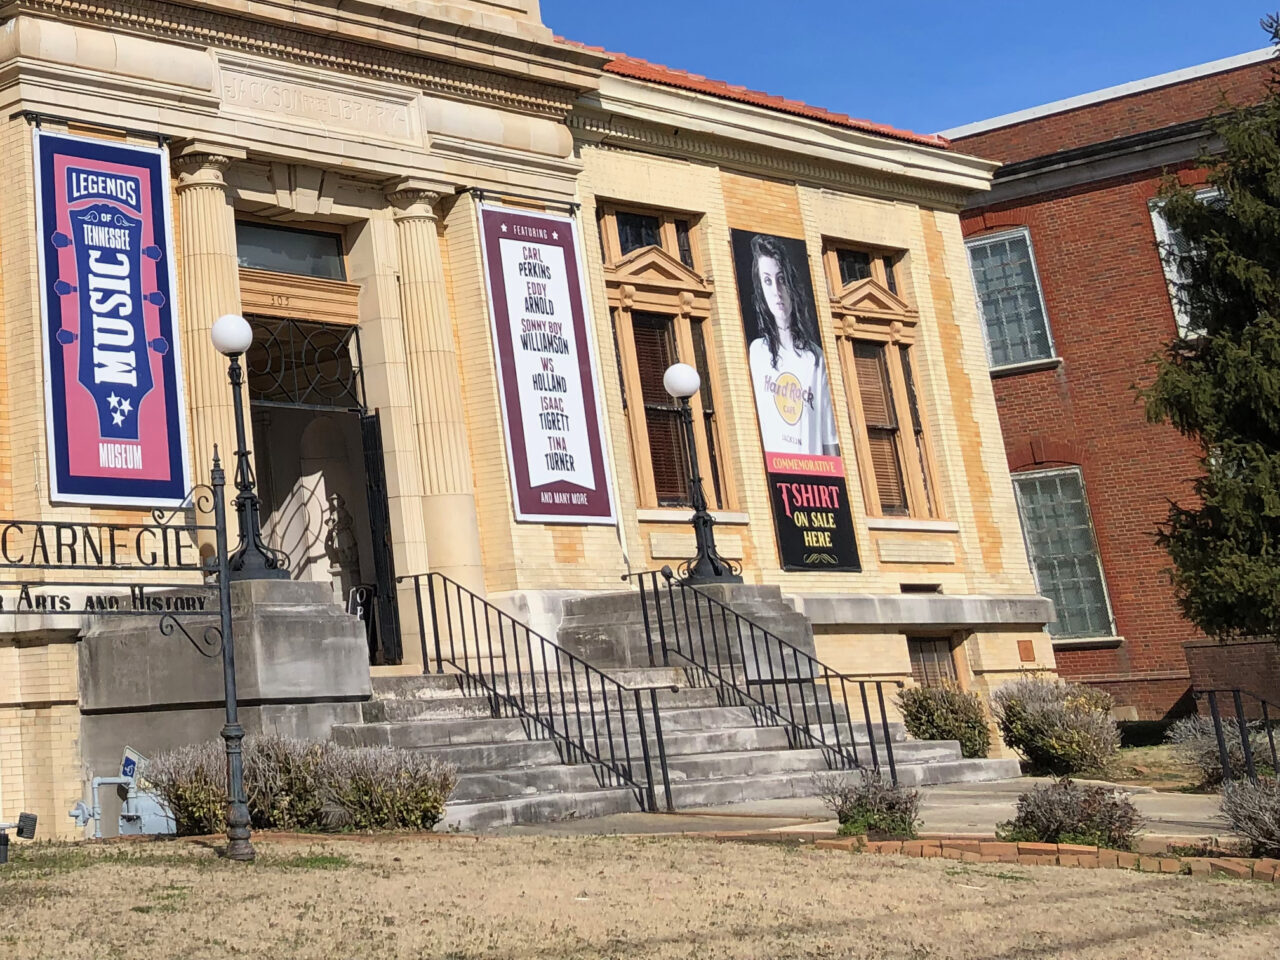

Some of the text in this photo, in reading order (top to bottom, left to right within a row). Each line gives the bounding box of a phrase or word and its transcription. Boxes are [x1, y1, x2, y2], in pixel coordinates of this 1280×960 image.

[72, 172, 137, 206] LEGENDS
[100, 213, 113, 222] OF
[83, 224, 131, 251] TENNESSEE
[513, 225, 548, 240] FEATURING
[522, 246, 543, 263] CARL
[518, 262, 551, 280] PERKINS
[526, 281, 547, 298] EDDY
[524, 297, 554, 316] ARNOLD
[88, 250, 138, 387] MUSIC
[521, 319, 562, 337] SONNY BOY
[520, 332, 569, 355] WILLIAMSON
[540, 356, 554, 373] WS
[532, 373, 567, 393] HOLLAND
[764, 375, 815, 411] Hard Rock
[540, 395, 564, 413] ISAAC
[539, 412, 570, 432] TIGRETT
[547, 436, 567, 453] TINA
[98, 442, 143, 470] MUSEUM
[545, 452, 576, 472] TURNER
[772, 457, 837, 473] COMMEMORATIVE
[540, 491, 588, 505] AND MANY MORE
[793, 511, 836, 529] ON SALE
[1, 523, 198, 567] CARNEGIE
[803, 531, 833, 548] HERE
[17, 584, 71, 611] ARTS
[84, 595, 120, 611] AND
[130, 584, 207, 612] HISTORY
